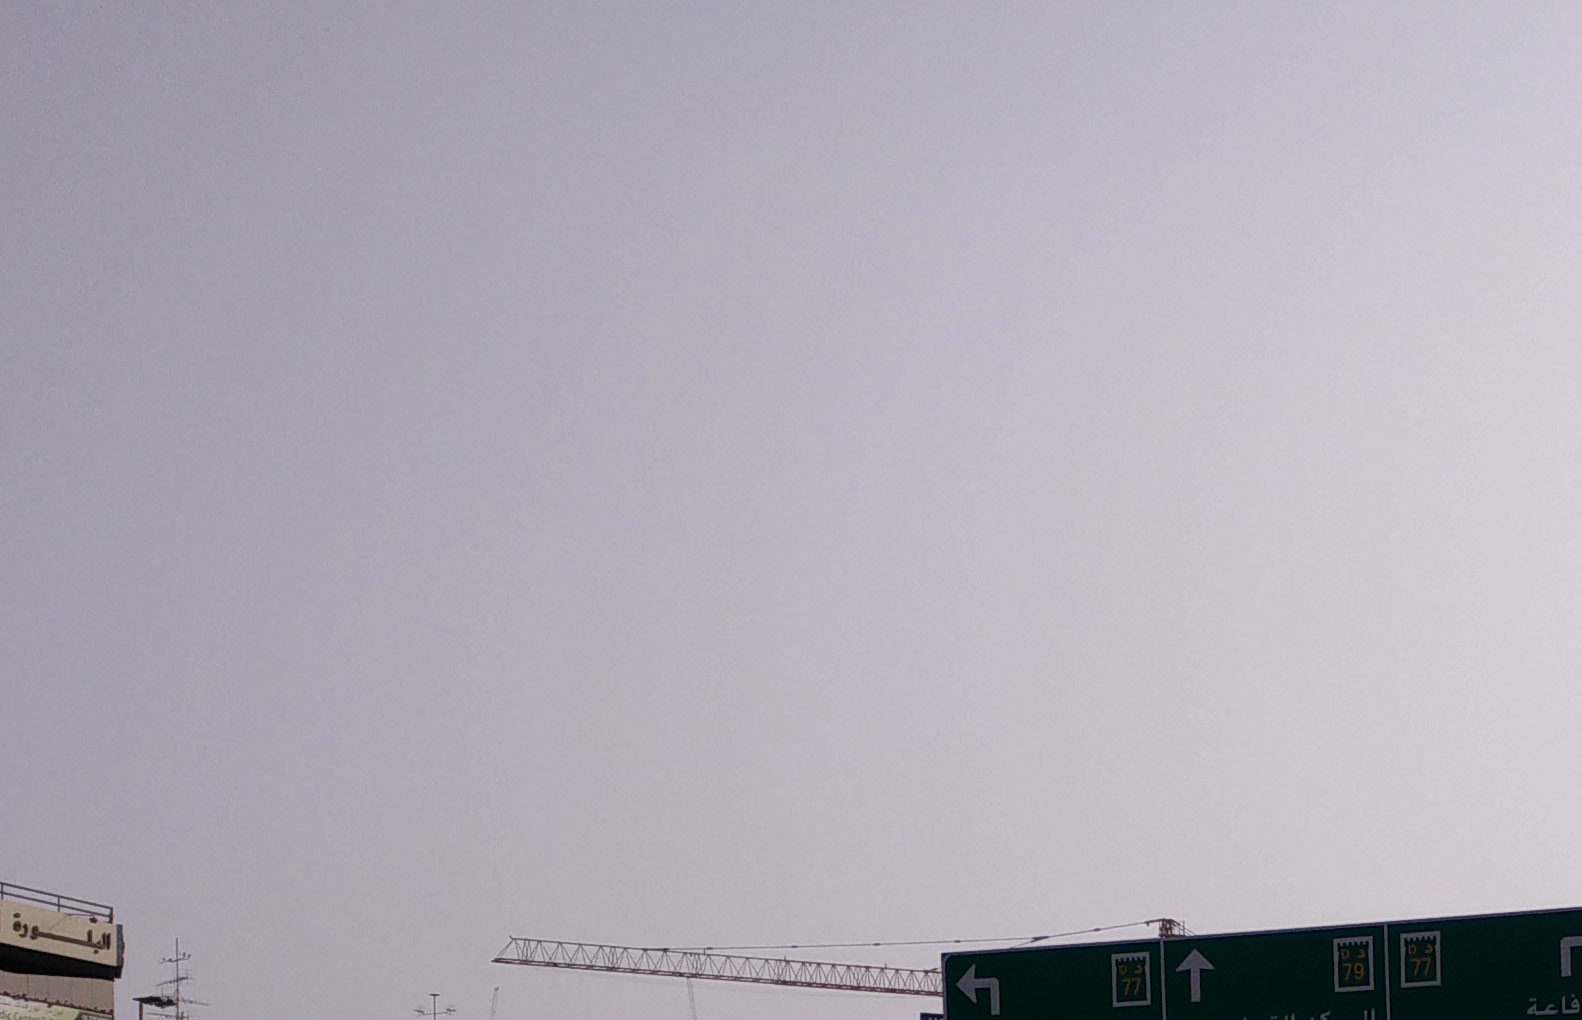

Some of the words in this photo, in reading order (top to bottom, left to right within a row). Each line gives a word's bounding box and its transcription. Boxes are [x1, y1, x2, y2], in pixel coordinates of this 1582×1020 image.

[1342, 963, 1365, 982] 79
[1411, 957, 1432, 977] 77
[1121, 977, 1142, 997] 77
